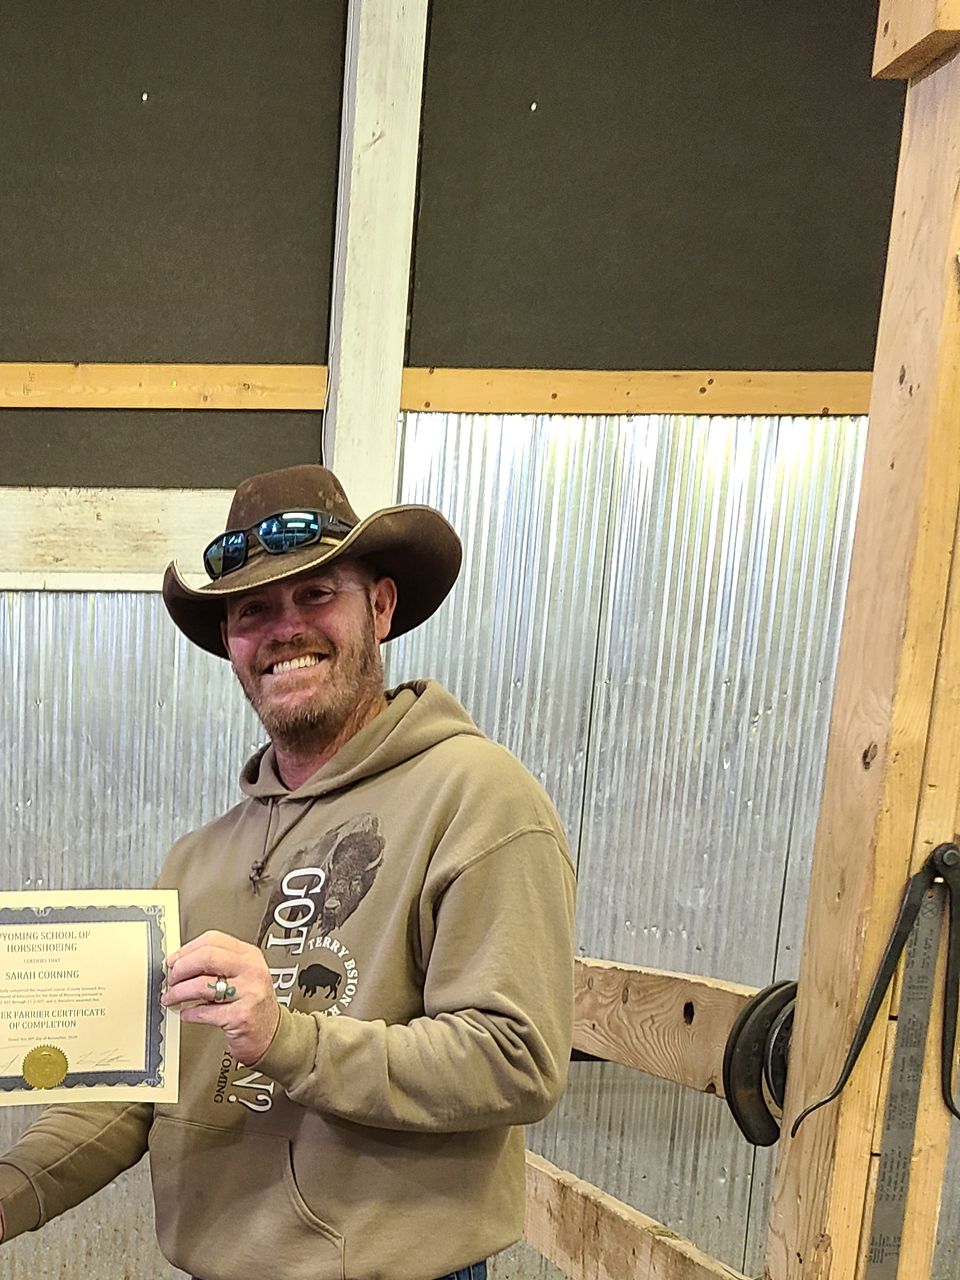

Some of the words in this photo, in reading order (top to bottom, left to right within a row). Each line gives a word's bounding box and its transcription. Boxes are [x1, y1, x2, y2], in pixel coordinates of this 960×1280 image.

[267, 866, 326, 954] GOT
[40, 931, 77, 940] SCHOOL
[78, 930, 90, 939] OF
[6, 943, 77, 953] HORSESHOEING
[307, 936, 349, 958] TERRY
[5, 971, 36, 981] SARAH
[38, 969, 79, 979] CORNING
[14, 1010, 50, 1019] FARRIER
[51, 1008, 106, 1018] CERTIFICATE
[8, 1021, 20, 1030] OF
[21, 1020, 77, 1029] COMPLETION
[214, 1050, 234, 1103] YOMING
